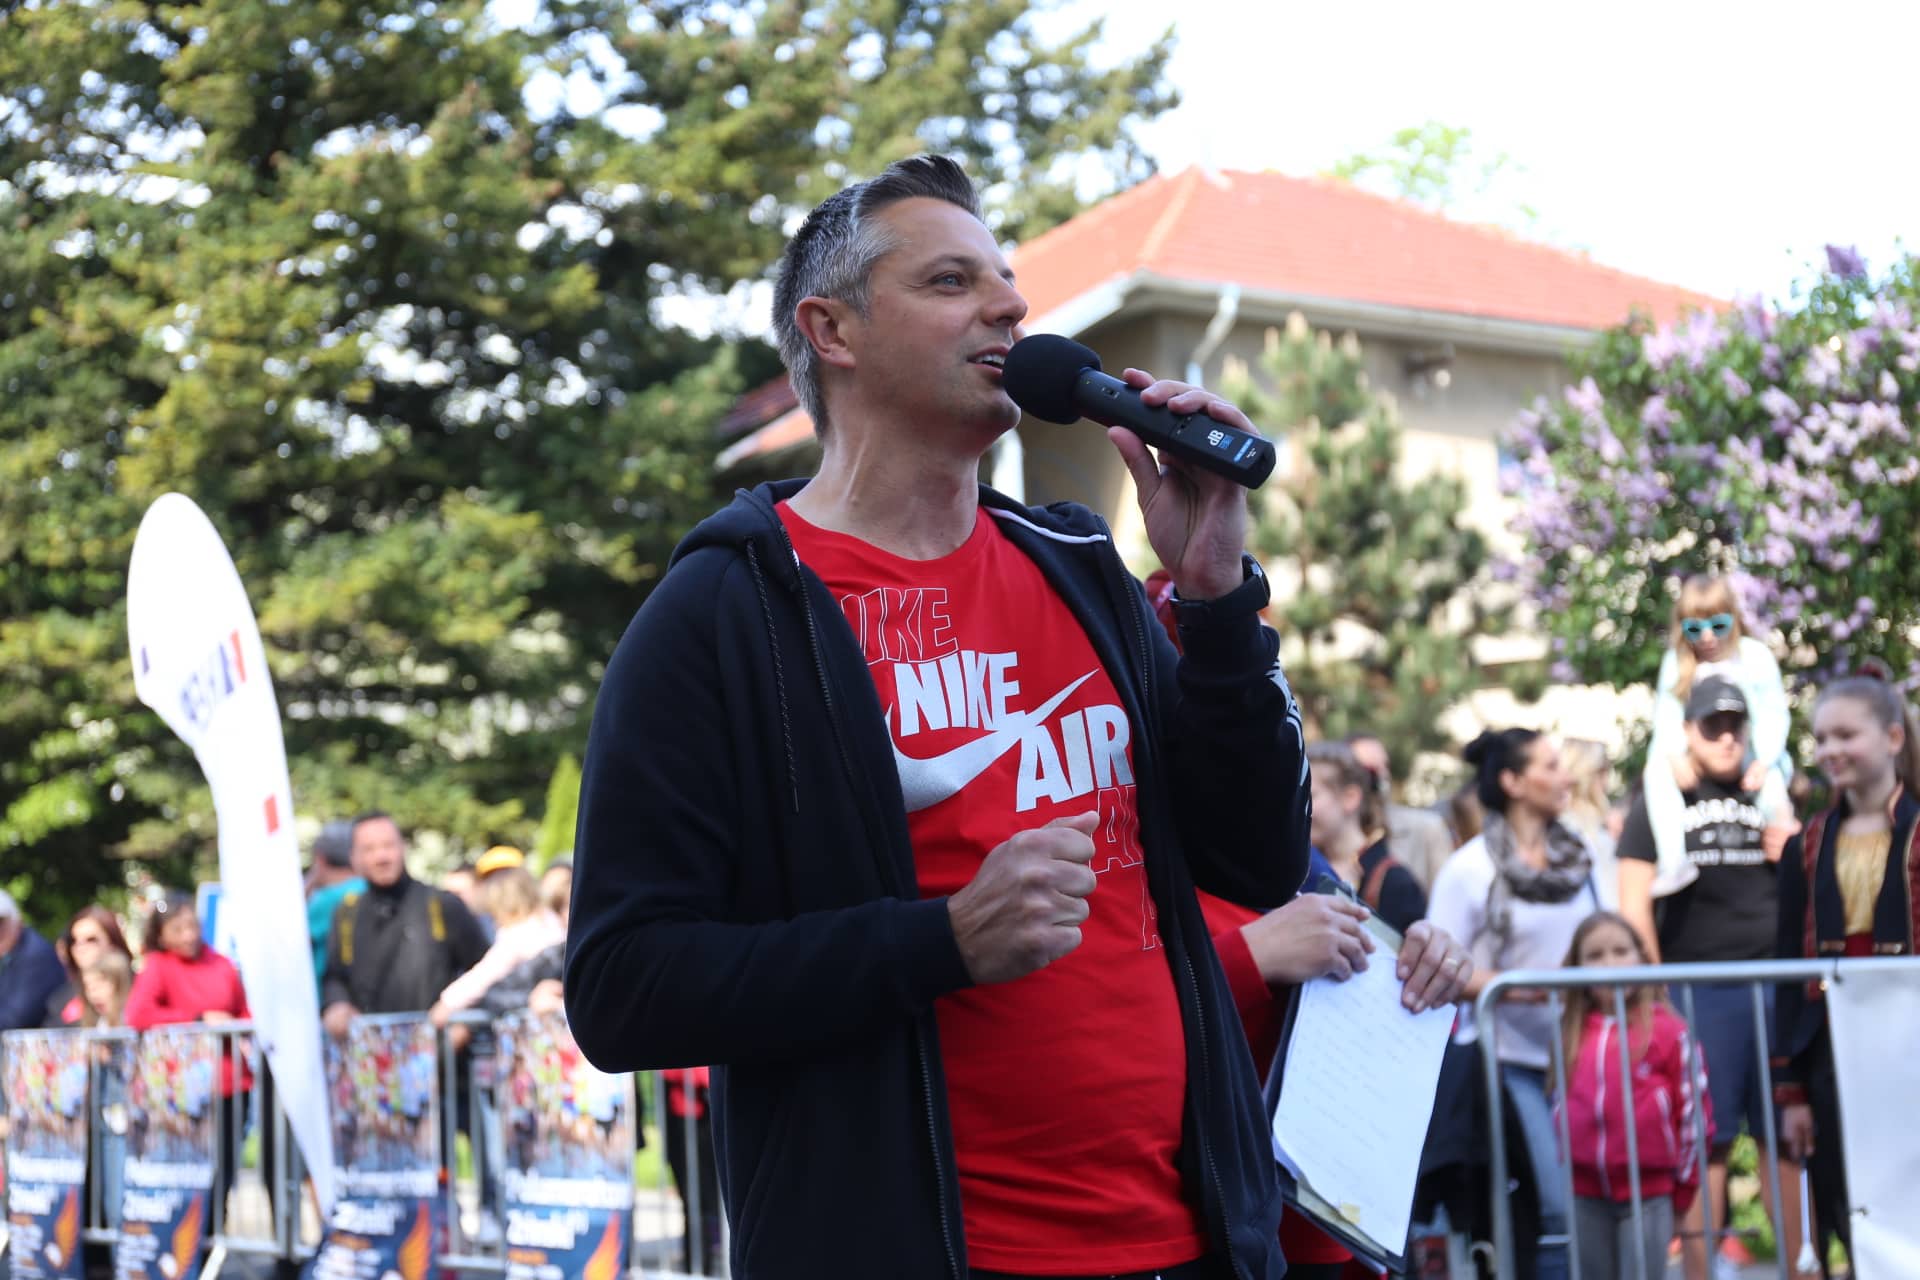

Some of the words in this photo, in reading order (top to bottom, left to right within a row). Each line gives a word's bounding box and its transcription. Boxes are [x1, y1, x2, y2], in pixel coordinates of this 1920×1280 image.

[1207, 429, 1225, 447] dB
[893, 650, 1021, 738] NIKE
[1016, 703, 1135, 813] AIR
